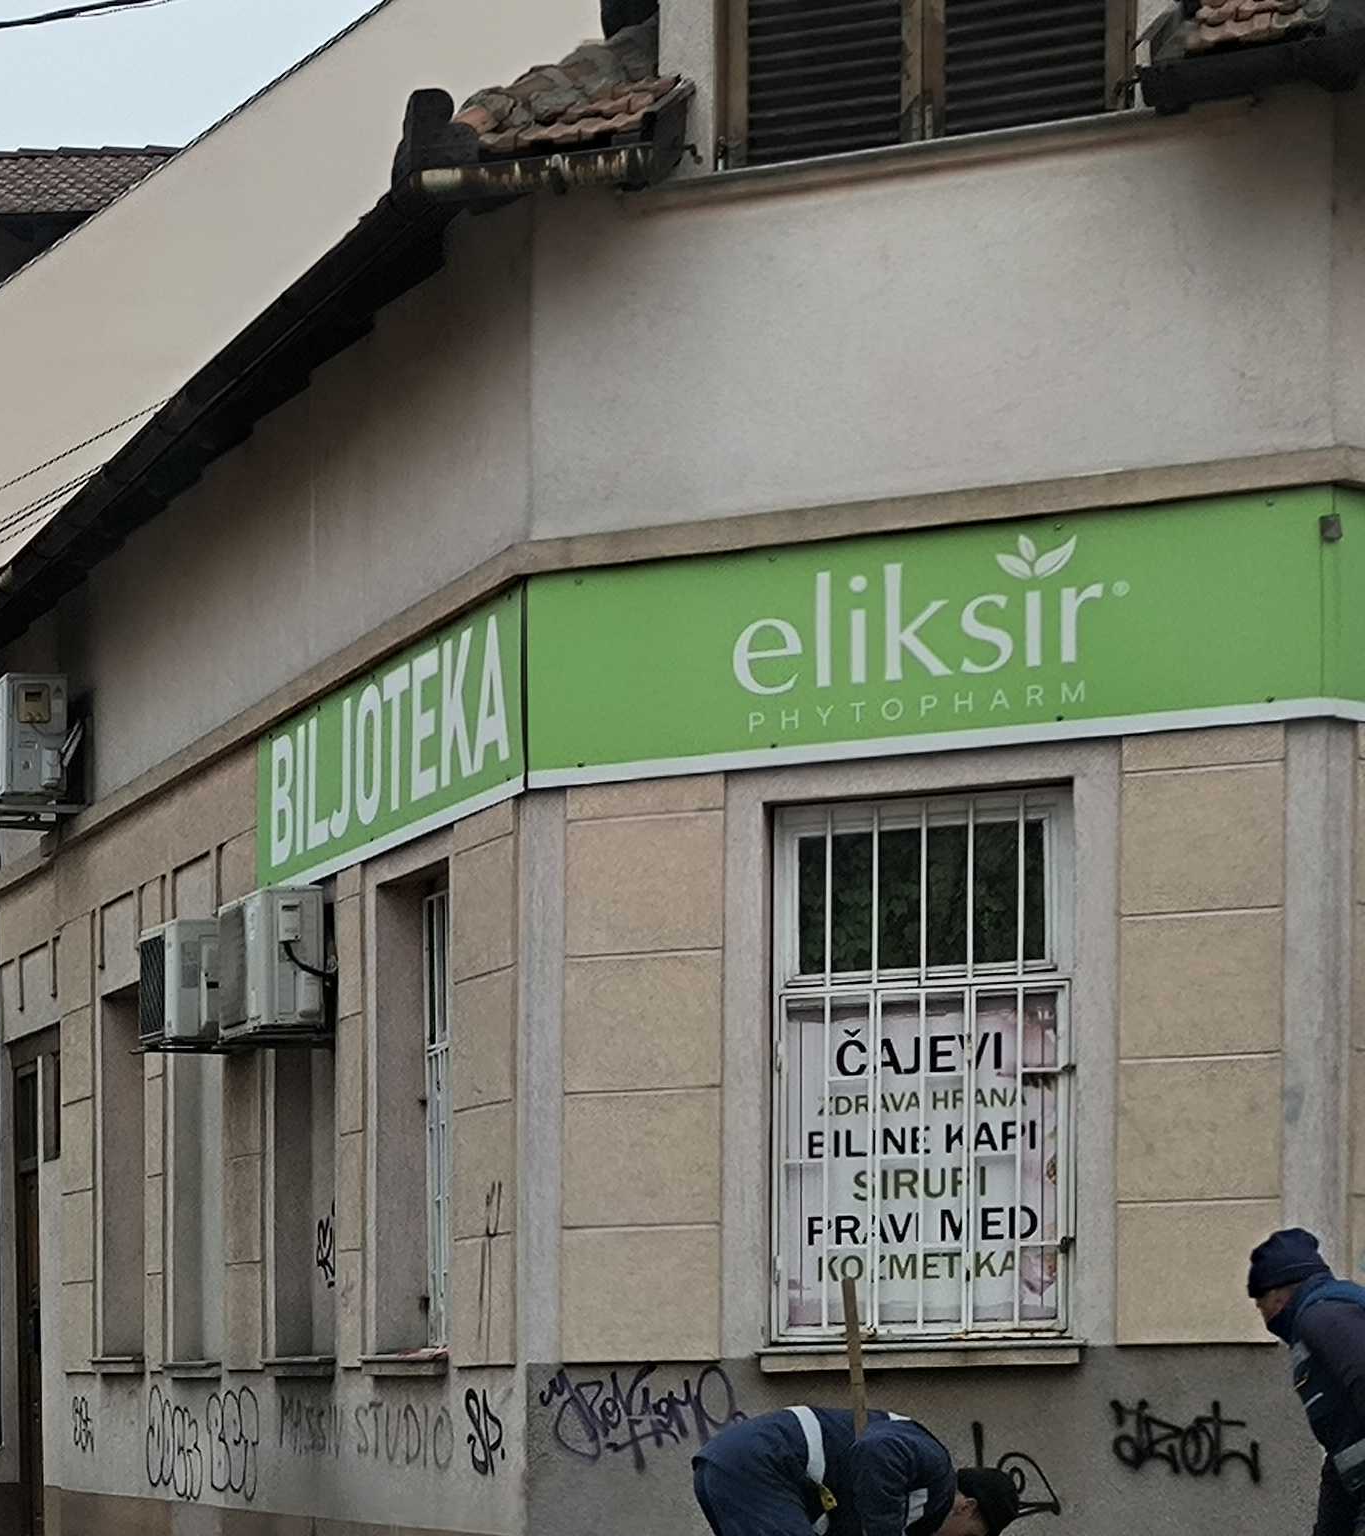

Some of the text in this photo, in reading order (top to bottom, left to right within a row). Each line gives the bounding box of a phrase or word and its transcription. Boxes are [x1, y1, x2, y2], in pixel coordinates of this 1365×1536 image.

[732, 562, 1104, 695] eliksir
[747, 681, 1086, 734] PHYTOPHARM
[271, 614, 510, 867] BILJOTEKA
[836, 1028, 1002, 1077] ČAJEVI
[818, 1087, 1027, 1116] ZDRAVA HRANA
[945, 1120, 1036, 1153] KAPI
[852, 1166, 986, 1201] SIRUPI
[807, 1205, 1038, 1246] PRAVI MED
[354, 1399, 455, 1470] STUDIO
